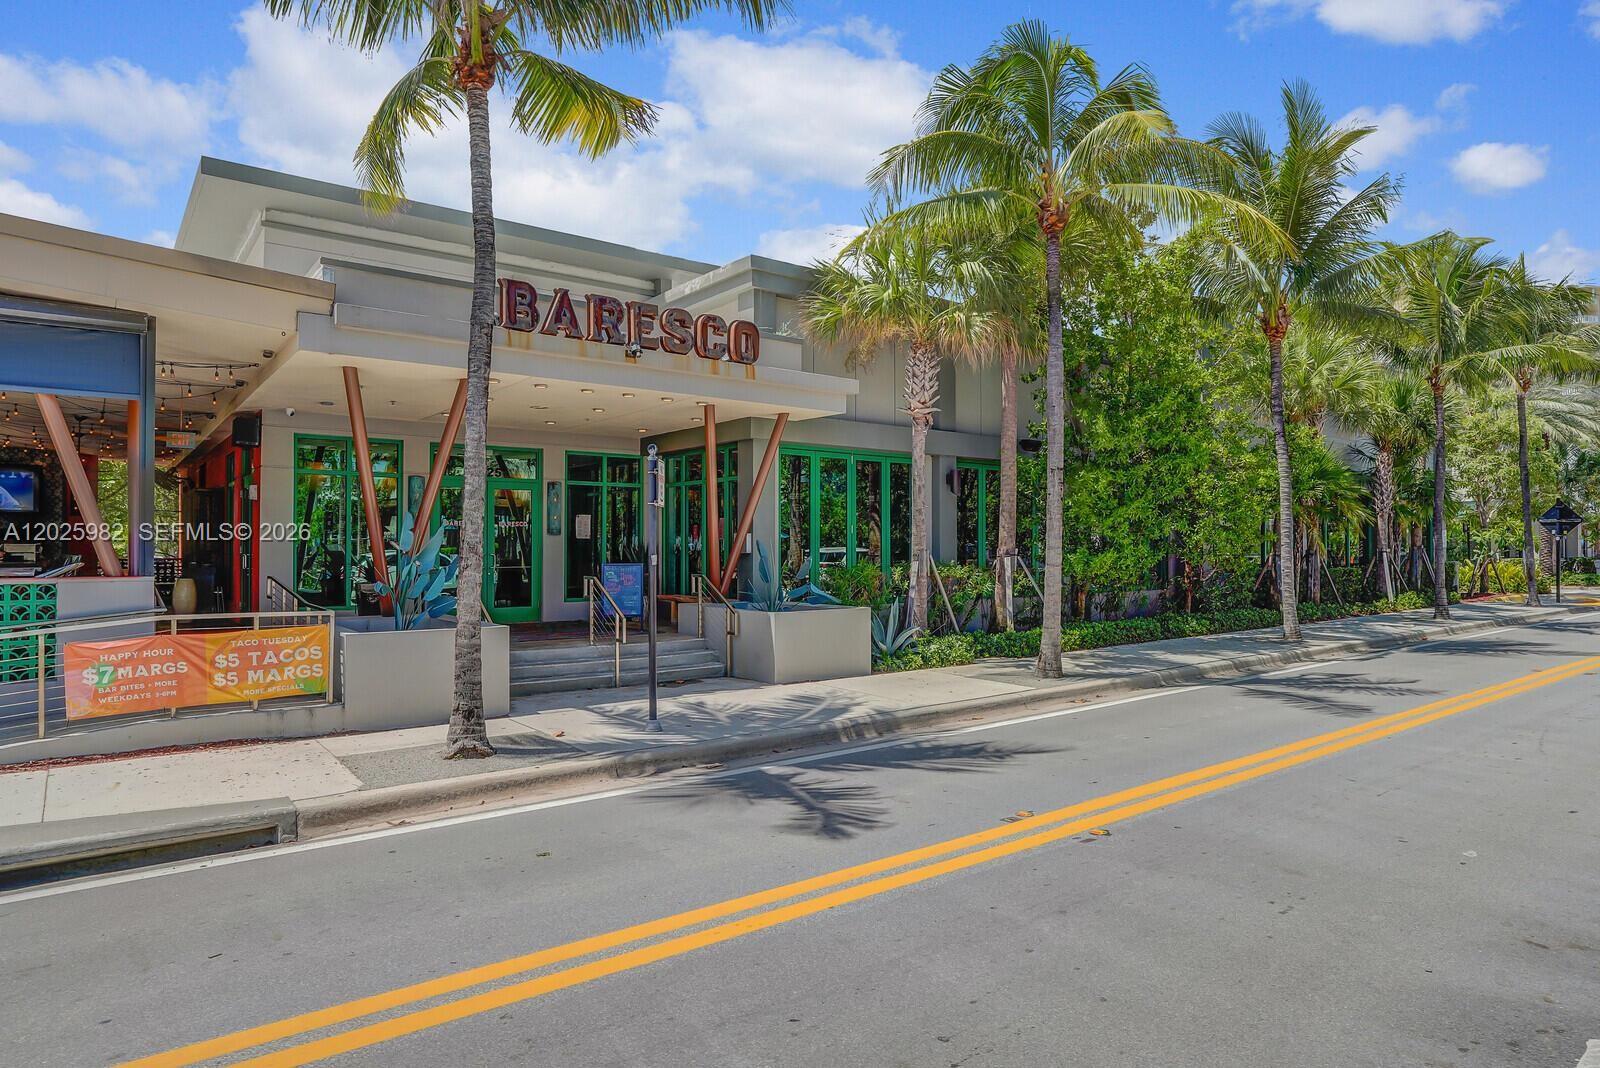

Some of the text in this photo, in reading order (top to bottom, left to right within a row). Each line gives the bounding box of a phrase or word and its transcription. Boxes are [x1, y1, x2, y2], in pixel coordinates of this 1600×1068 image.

[498, 278, 760, 365] BARESCO
[231, 635, 307, 647] TACO TUESDAY
[100, 648, 174, 662] HAPPY HOUR
[214, 645, 323, 669] $5 TACOS
[82, 661, 188, 685] $7 MARGS
[213, 663, 323, 687] $5 MARGS
[120, 683, 145, 691] BITES
[98, 692, 151, 704] WEEKDAYS
